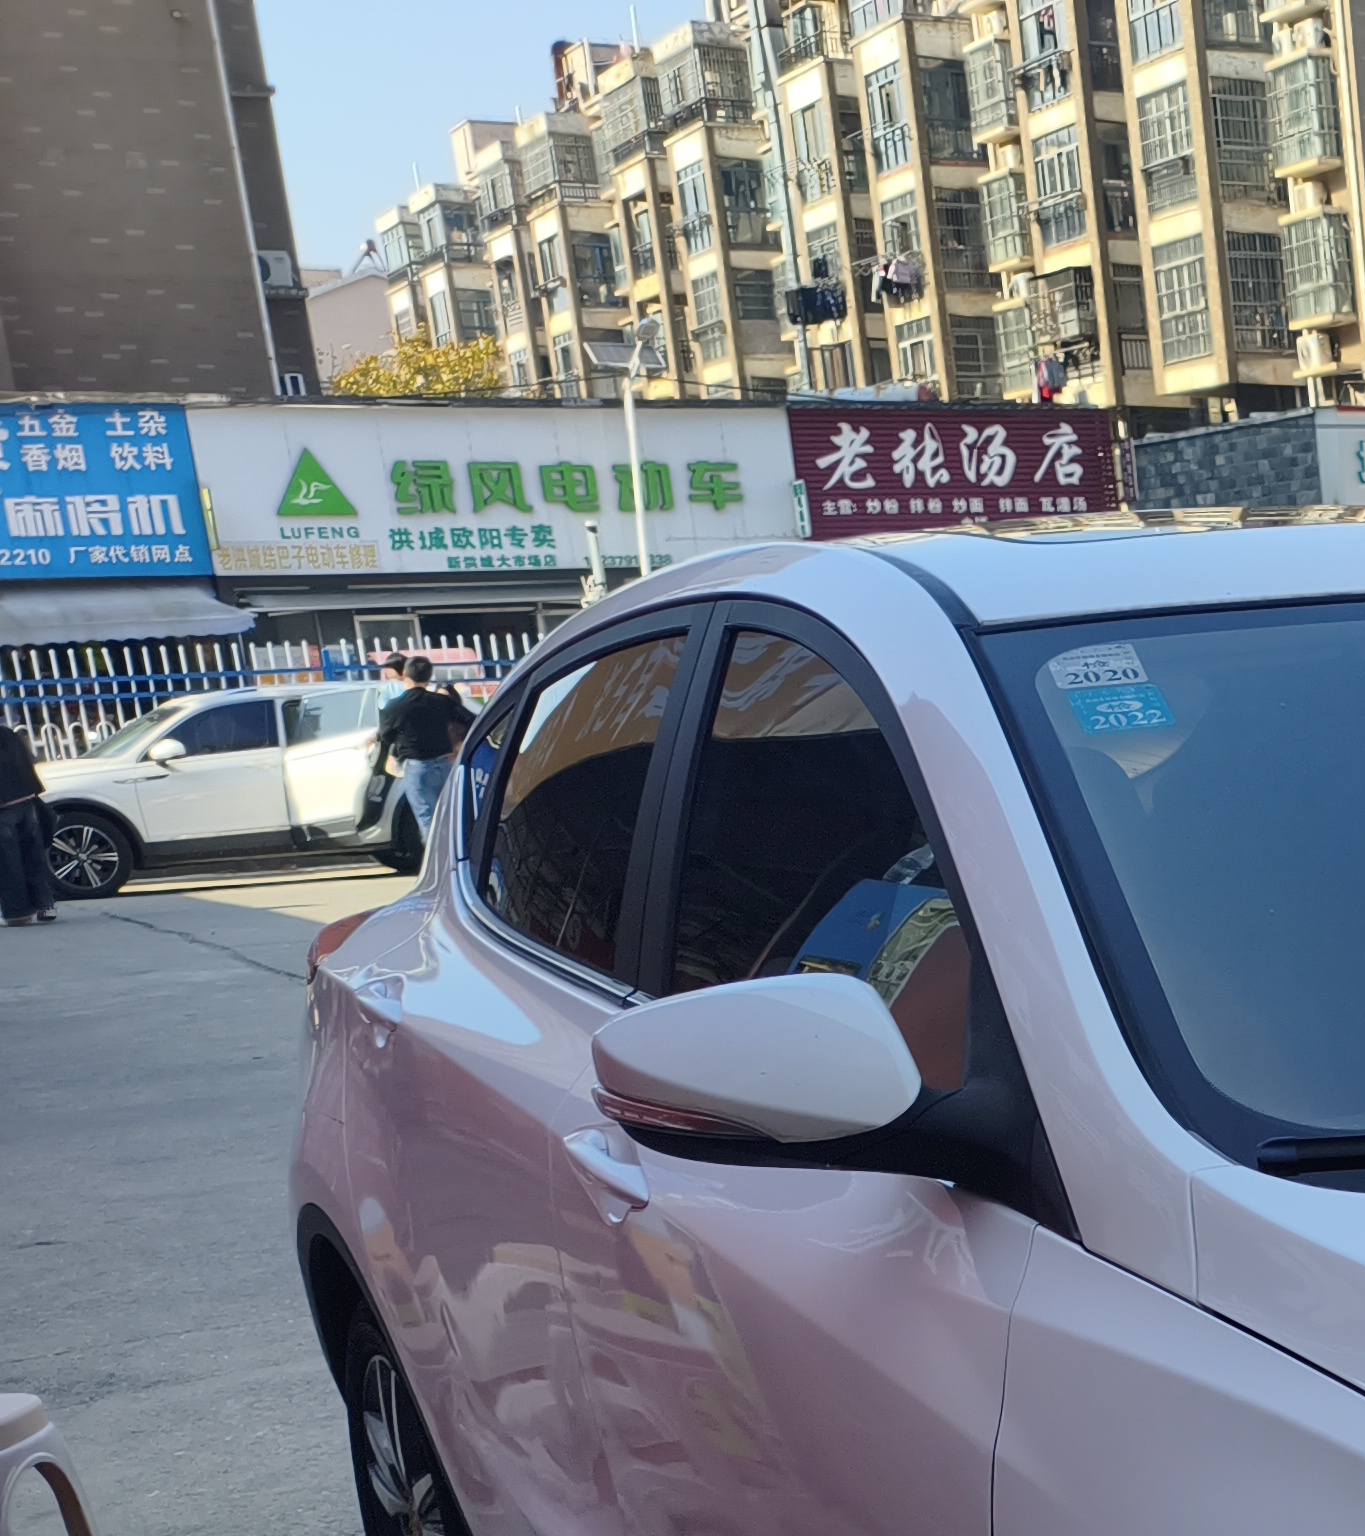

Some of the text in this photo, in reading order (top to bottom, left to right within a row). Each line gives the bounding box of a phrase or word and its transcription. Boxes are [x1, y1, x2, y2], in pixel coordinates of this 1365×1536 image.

[16, 408, 168, 437] 五金 土杂
[20, 443, 87, 471] 香烟
[110, 442, 174, 471] 饮料
[815, 421, 1084, 491] 老张汤店
[389, 460, 745, 515] 绿风电动车
[4, 494, 187, 537] 麻将机
[280, 526, 360, 540] LUFENG
[388, 524, 557, 552] 洪城欧阳专卖
[0, 544, 193, 566] 2210 厂家代销网点
[1065, 667, 1140, 685] 2020
[1089, 709, 1166, 730] 2022
